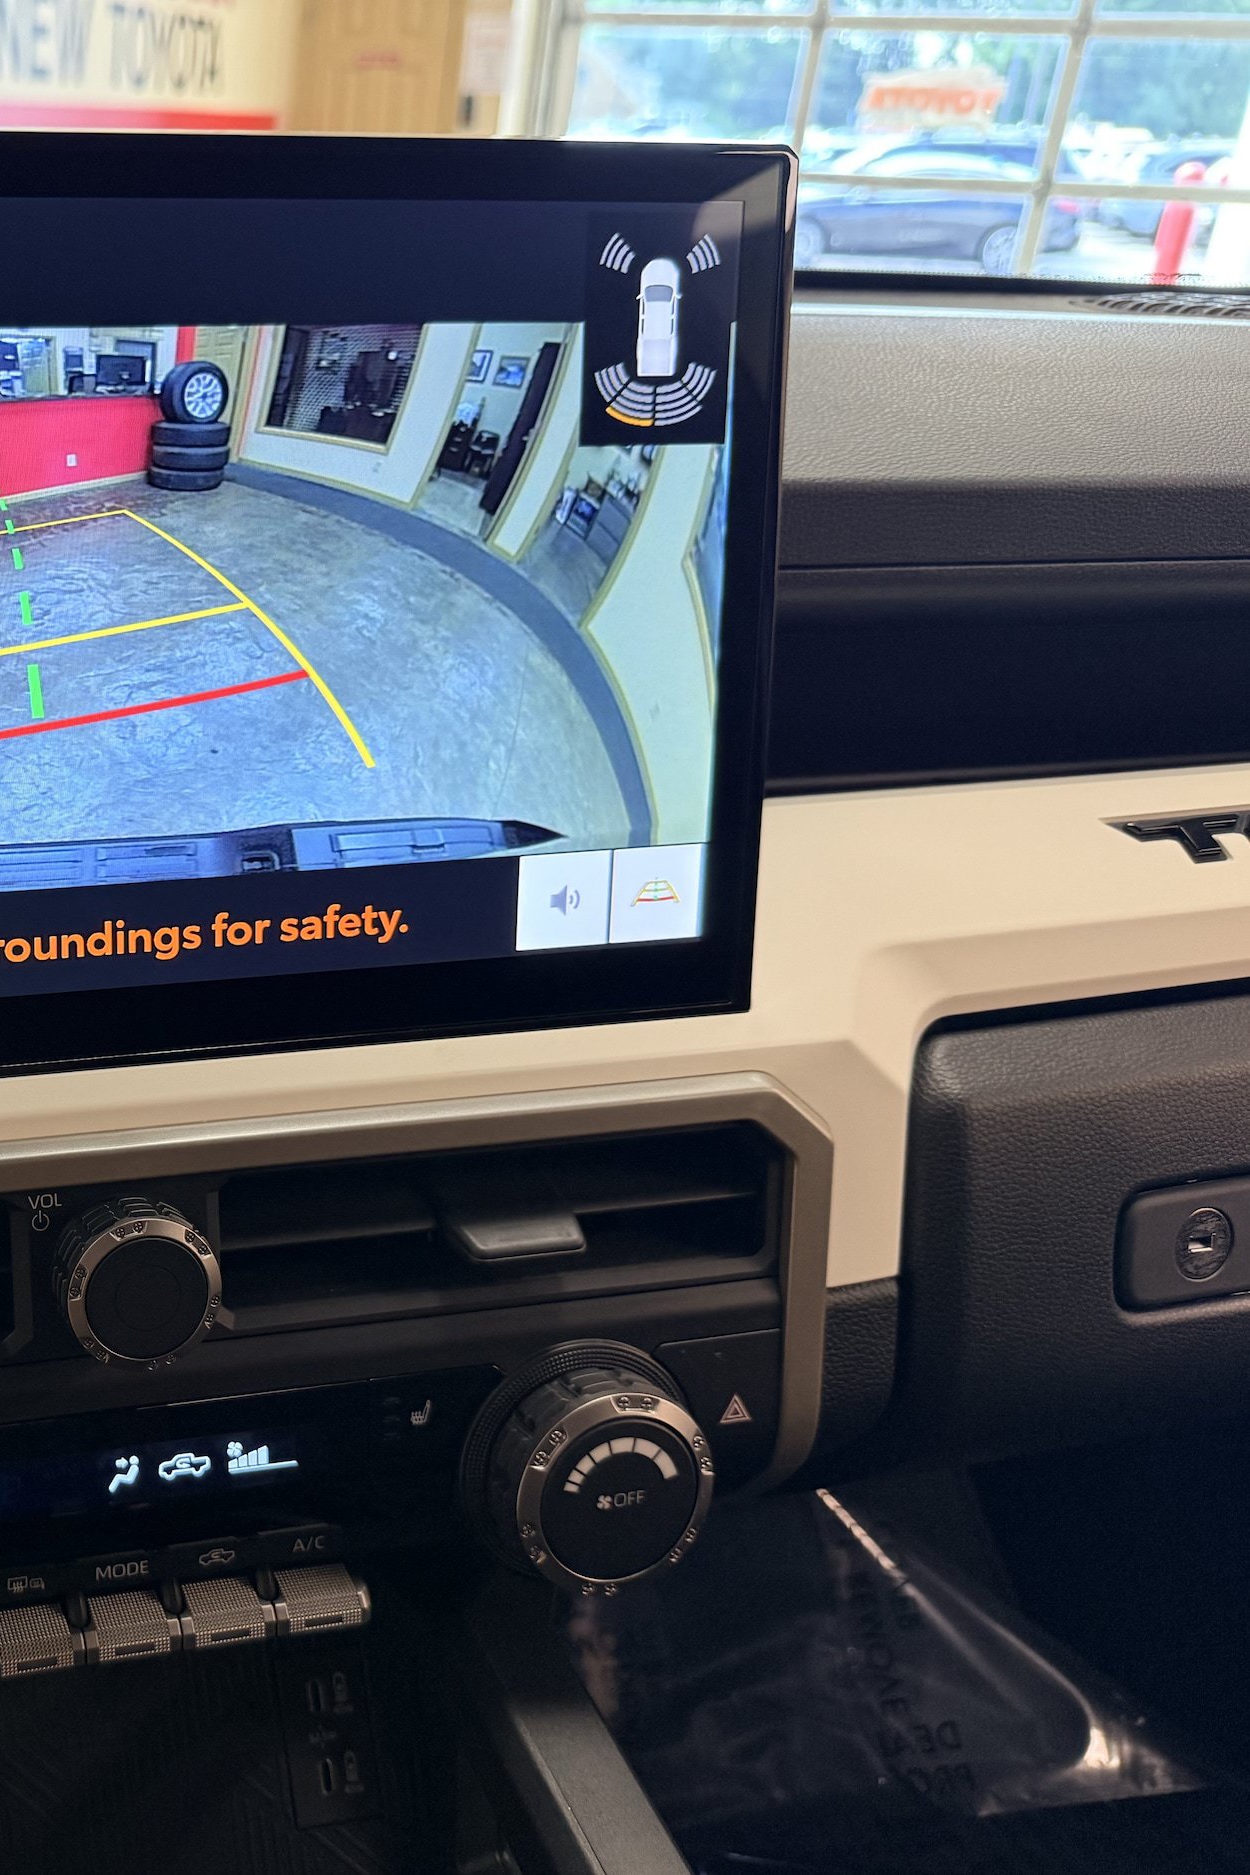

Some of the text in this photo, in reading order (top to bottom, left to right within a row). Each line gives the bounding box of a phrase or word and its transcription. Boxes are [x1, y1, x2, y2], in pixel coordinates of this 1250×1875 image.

[211, 911, 271, 948] for
[279, 903, 410, 944] safety.
[28, 1193, 62, 1210] VOL
[613, 1489, 646, 1508] OFF
[292, 1535, 326, 1553] A/C
[95, 1559, 150, 1581] MODE
